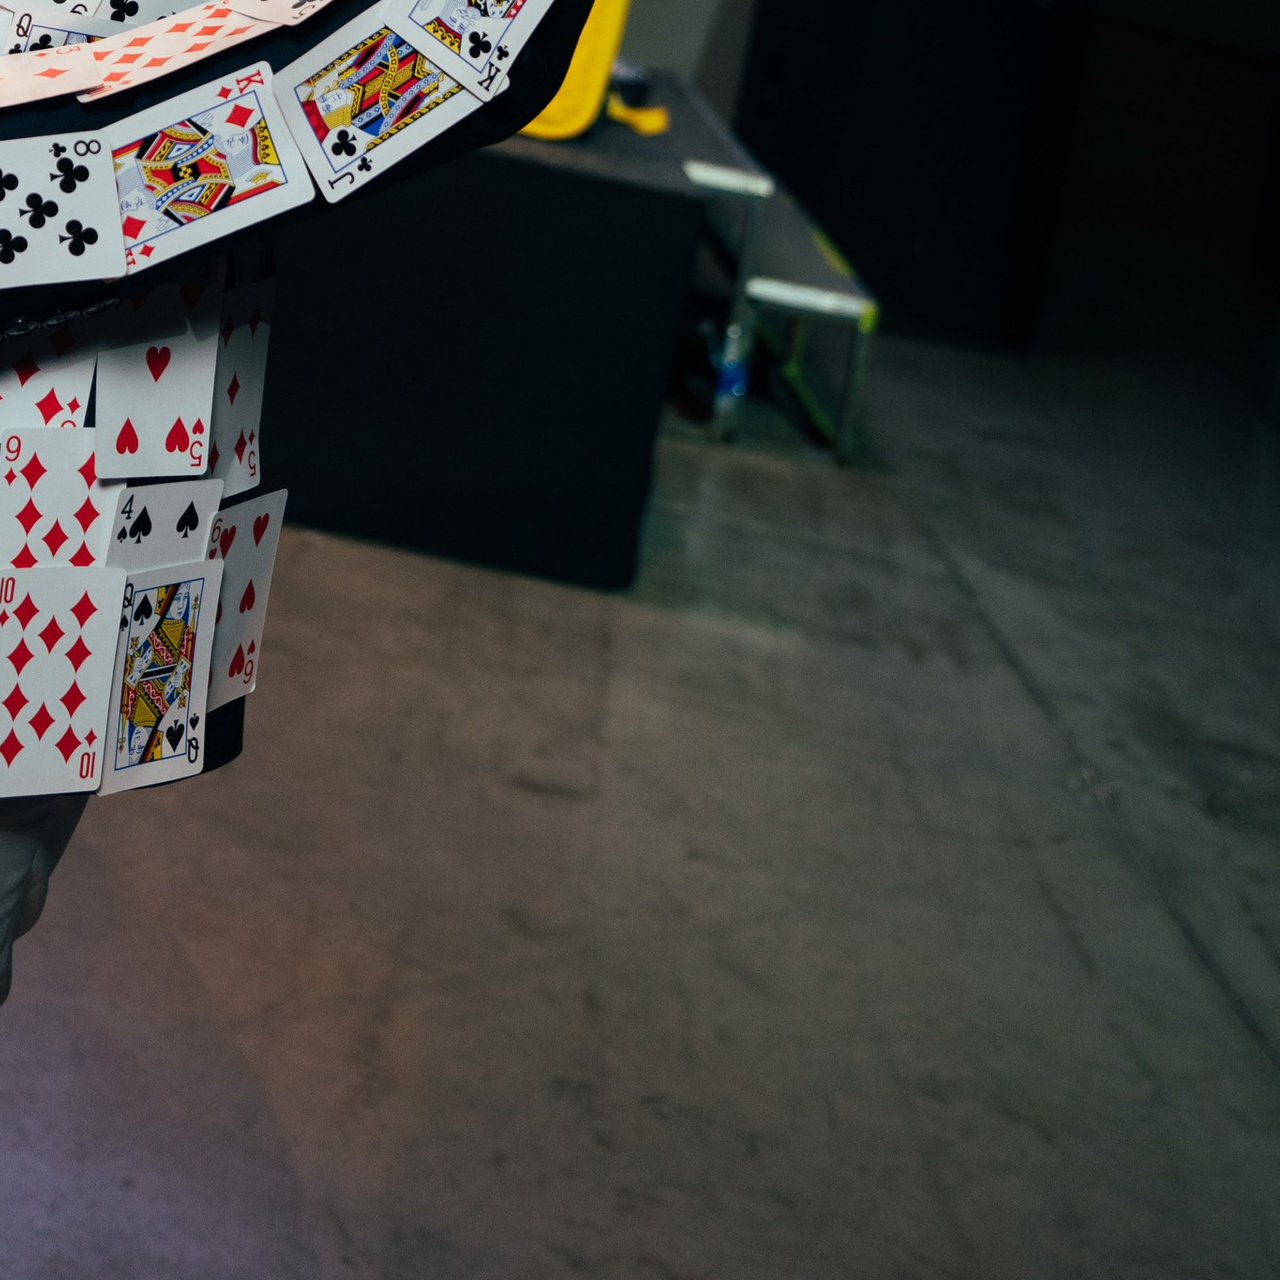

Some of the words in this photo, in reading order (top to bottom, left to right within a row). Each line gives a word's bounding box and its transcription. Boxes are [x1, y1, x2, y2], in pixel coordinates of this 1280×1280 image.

[16, 13, 32, 38] Q
[56, 46, 80, 54] 3
[235, 70, 264, 94] K
[477, 63, 501, 92] K
[74, 140, 101, 156] 8
[328, 172, 354, 189] J
[6, 436, 21, 461] 9
[190, 441, 203, 466] 5
[248, 451, 256, 476] 5
[121, 494, 134, 520] 4
[211, 518, 222, 543] 6
[0, 577, 15, 603] 10
[123, 583, 134, 608] Q
[187, 737, 199, 764] Q
[80, 752, 95, 779] 10
